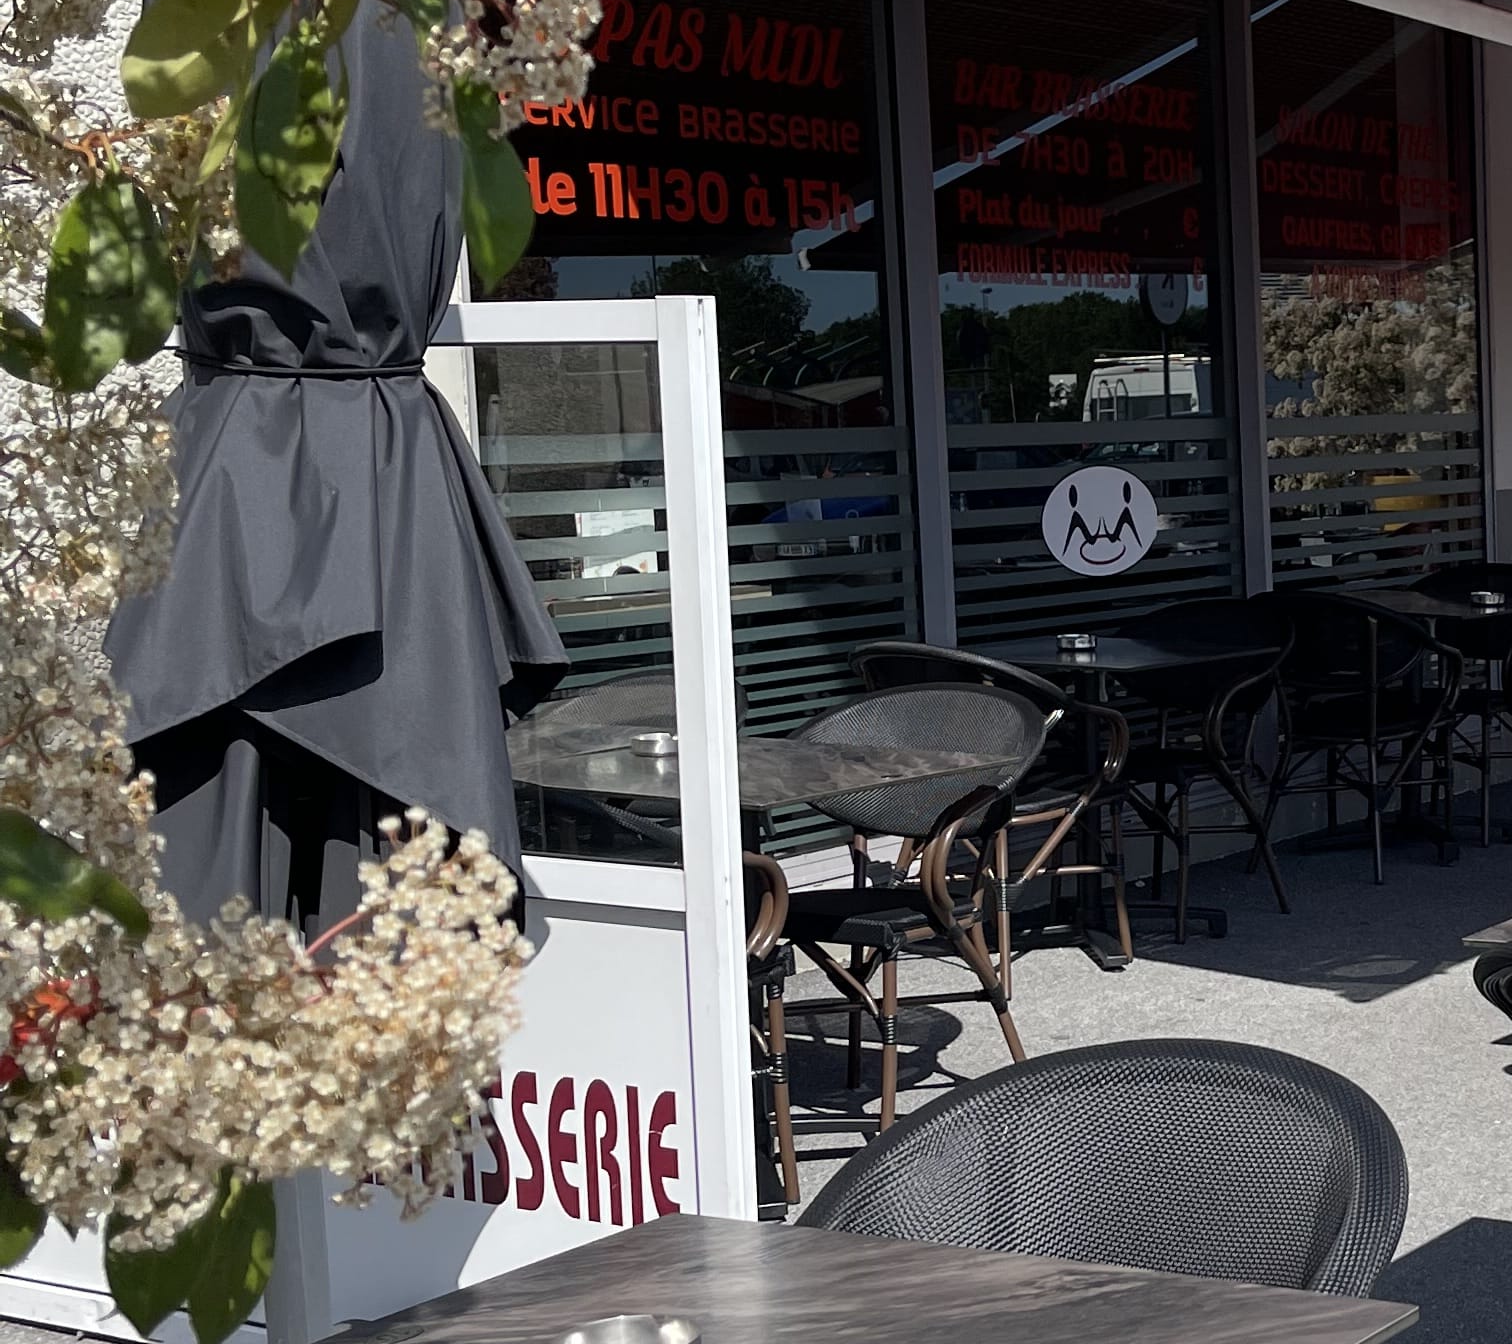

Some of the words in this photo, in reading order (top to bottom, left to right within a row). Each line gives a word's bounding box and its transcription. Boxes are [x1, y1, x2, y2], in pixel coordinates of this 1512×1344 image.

[720, 12, 844, 89] MIDI
[953, 58, 1024, 110] BAR
[1031, 69, 1199, 131] BRASSERIE
[957, 124, 1001, 167] DE
[1015, 131, 1090, 176] 7H30
[1143, 146, 1196, 184] 20H
[1361, 116, 1391, 156] DE
[588, 162, 729, 225] 11H30
[784, 178, 862, 233] 15h
[958, 188, 1013, 227] Plat
[1018, 192, 1051, 230] du
[956, 243, 1048, 286] FORMULE
[1051, 248, 1132, 289] EXPRESS
[361, 1069, 681, 1229] SSERIE
